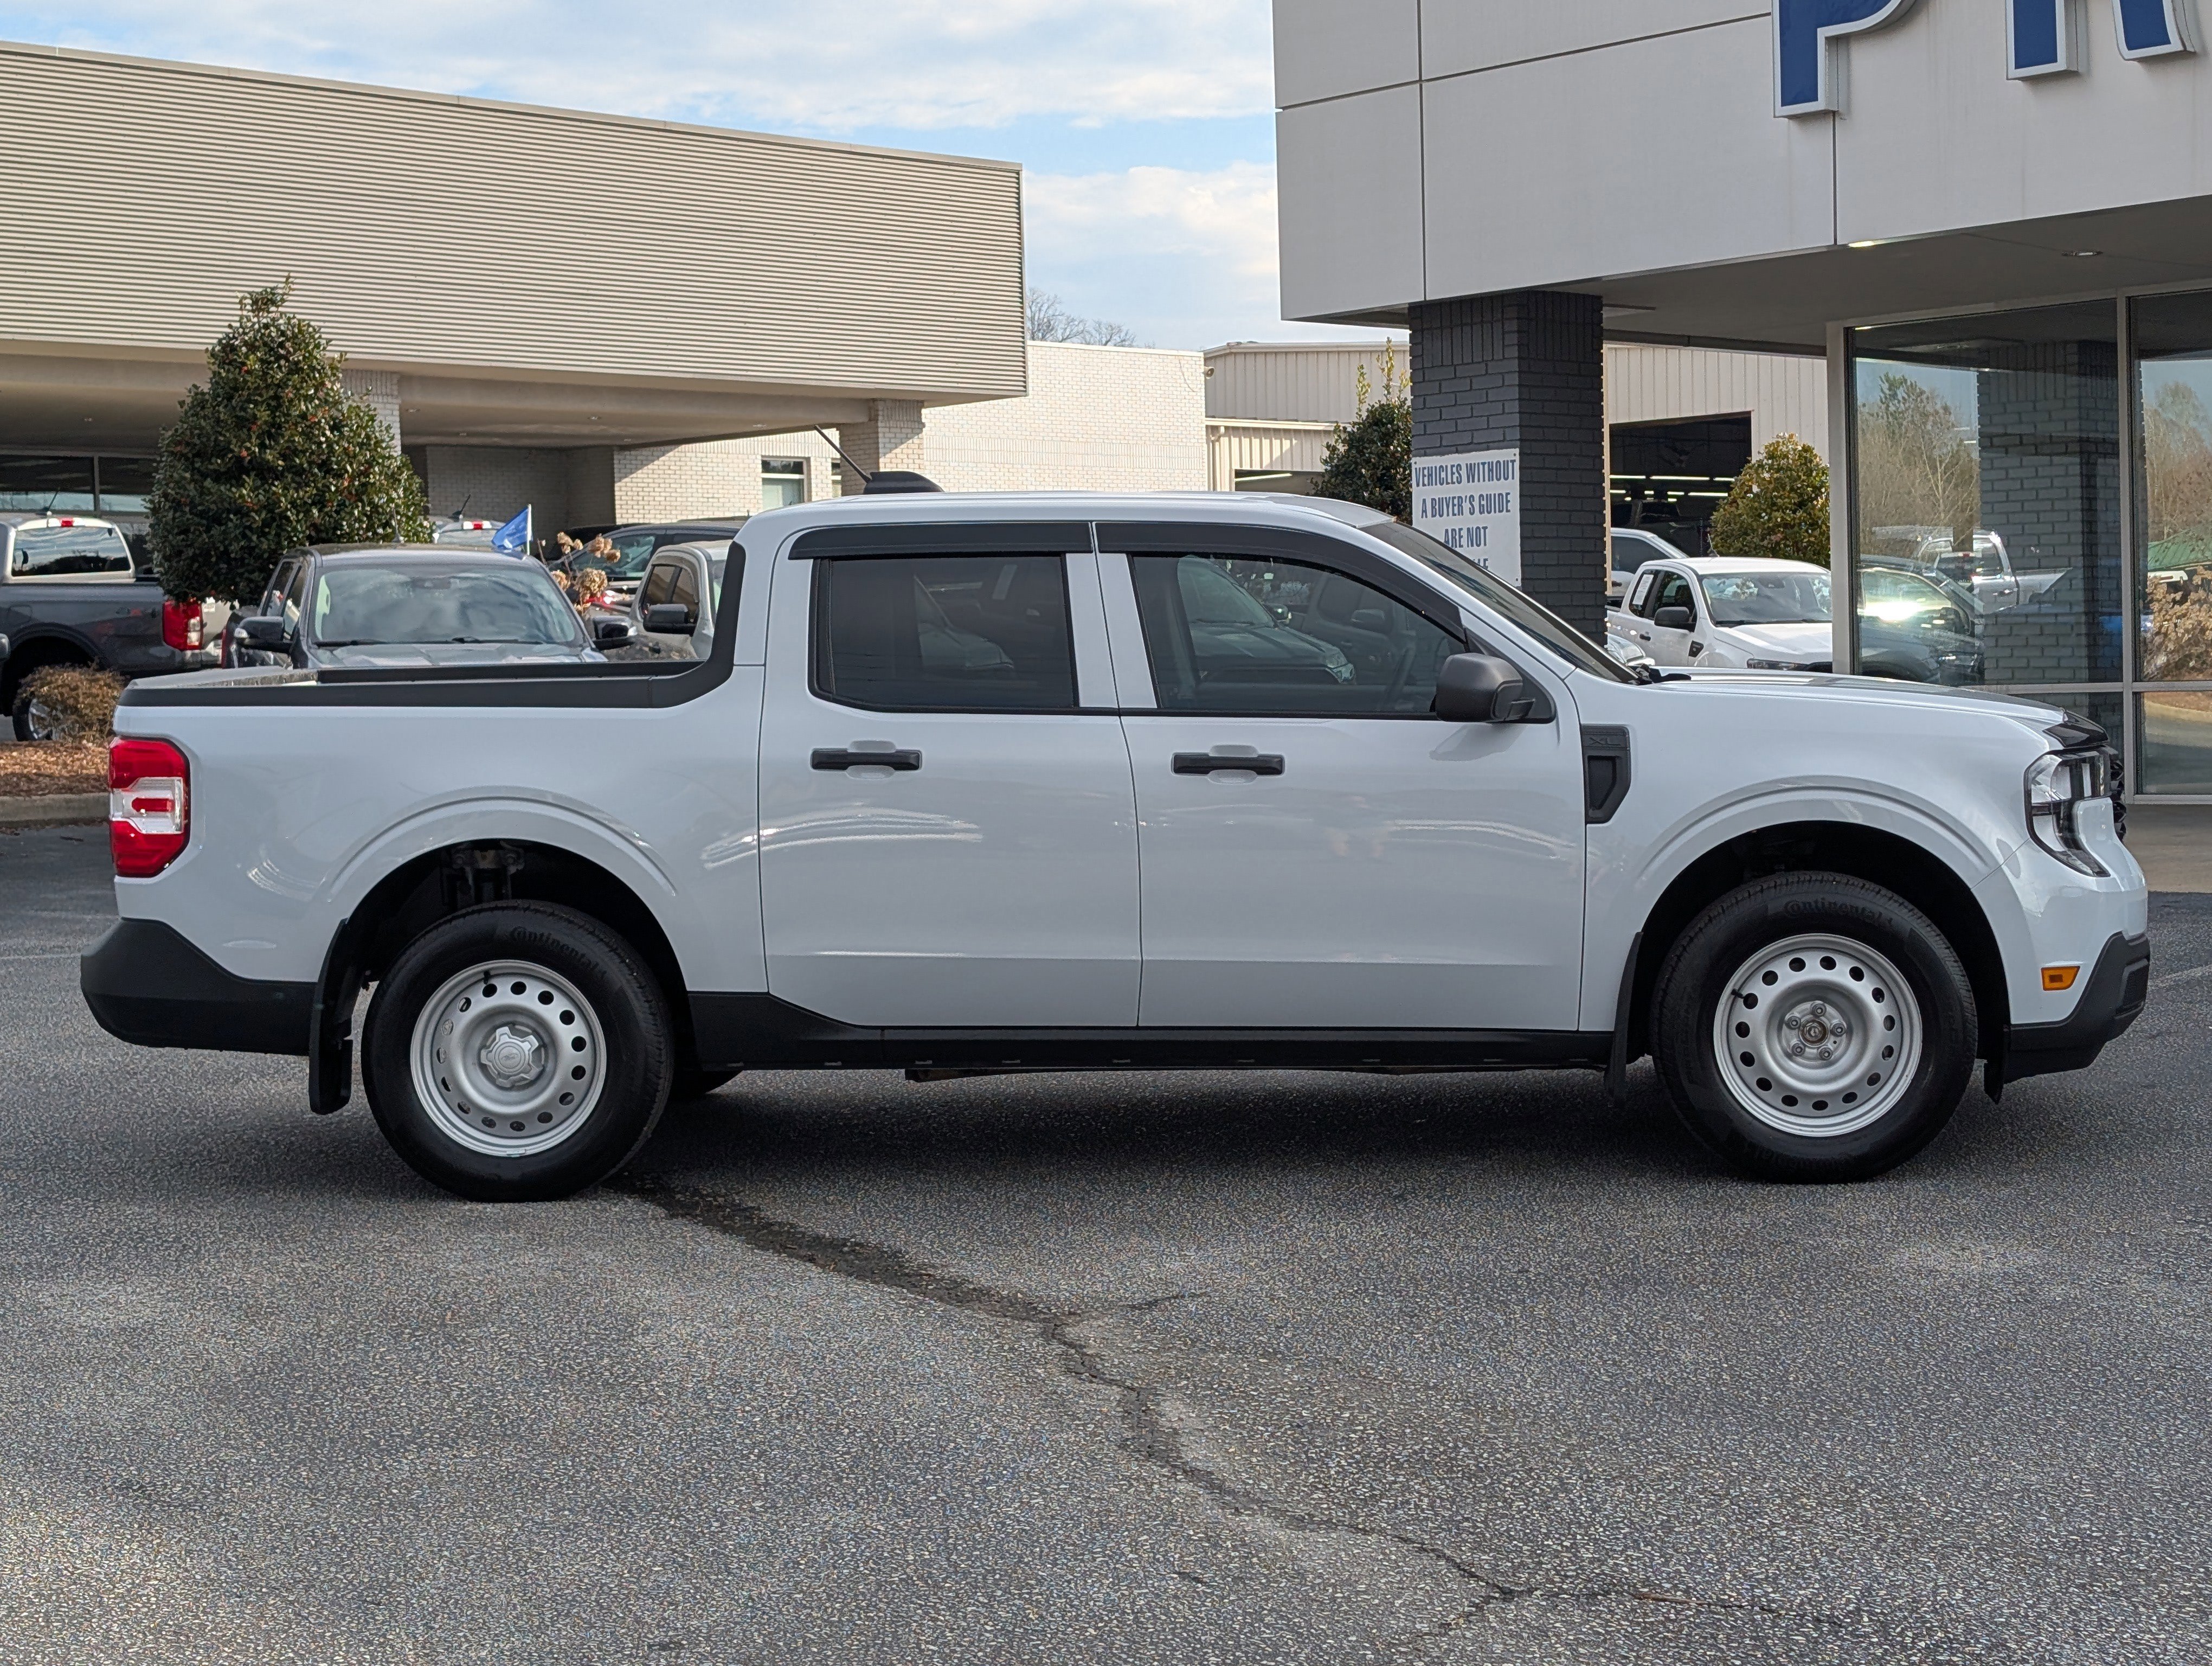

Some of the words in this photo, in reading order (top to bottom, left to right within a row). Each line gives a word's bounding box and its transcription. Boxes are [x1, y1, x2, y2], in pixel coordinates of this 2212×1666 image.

[1414, 463, 1463, 488] VEHICLES
[1465, 459, 1516, 484] WITHOUT
[1420, 498, 1428, 518] A
[1431, 494, 1475, 518] BUYER'S
[1478, 492, 1511, 515] GUIDE
[1444, 528, 1464, 548] ARE
[1467, 526, 1488, 548] NOT
[1589, 736, 1621, 746] XL
[1783, 897, 1883, 923] Continental
